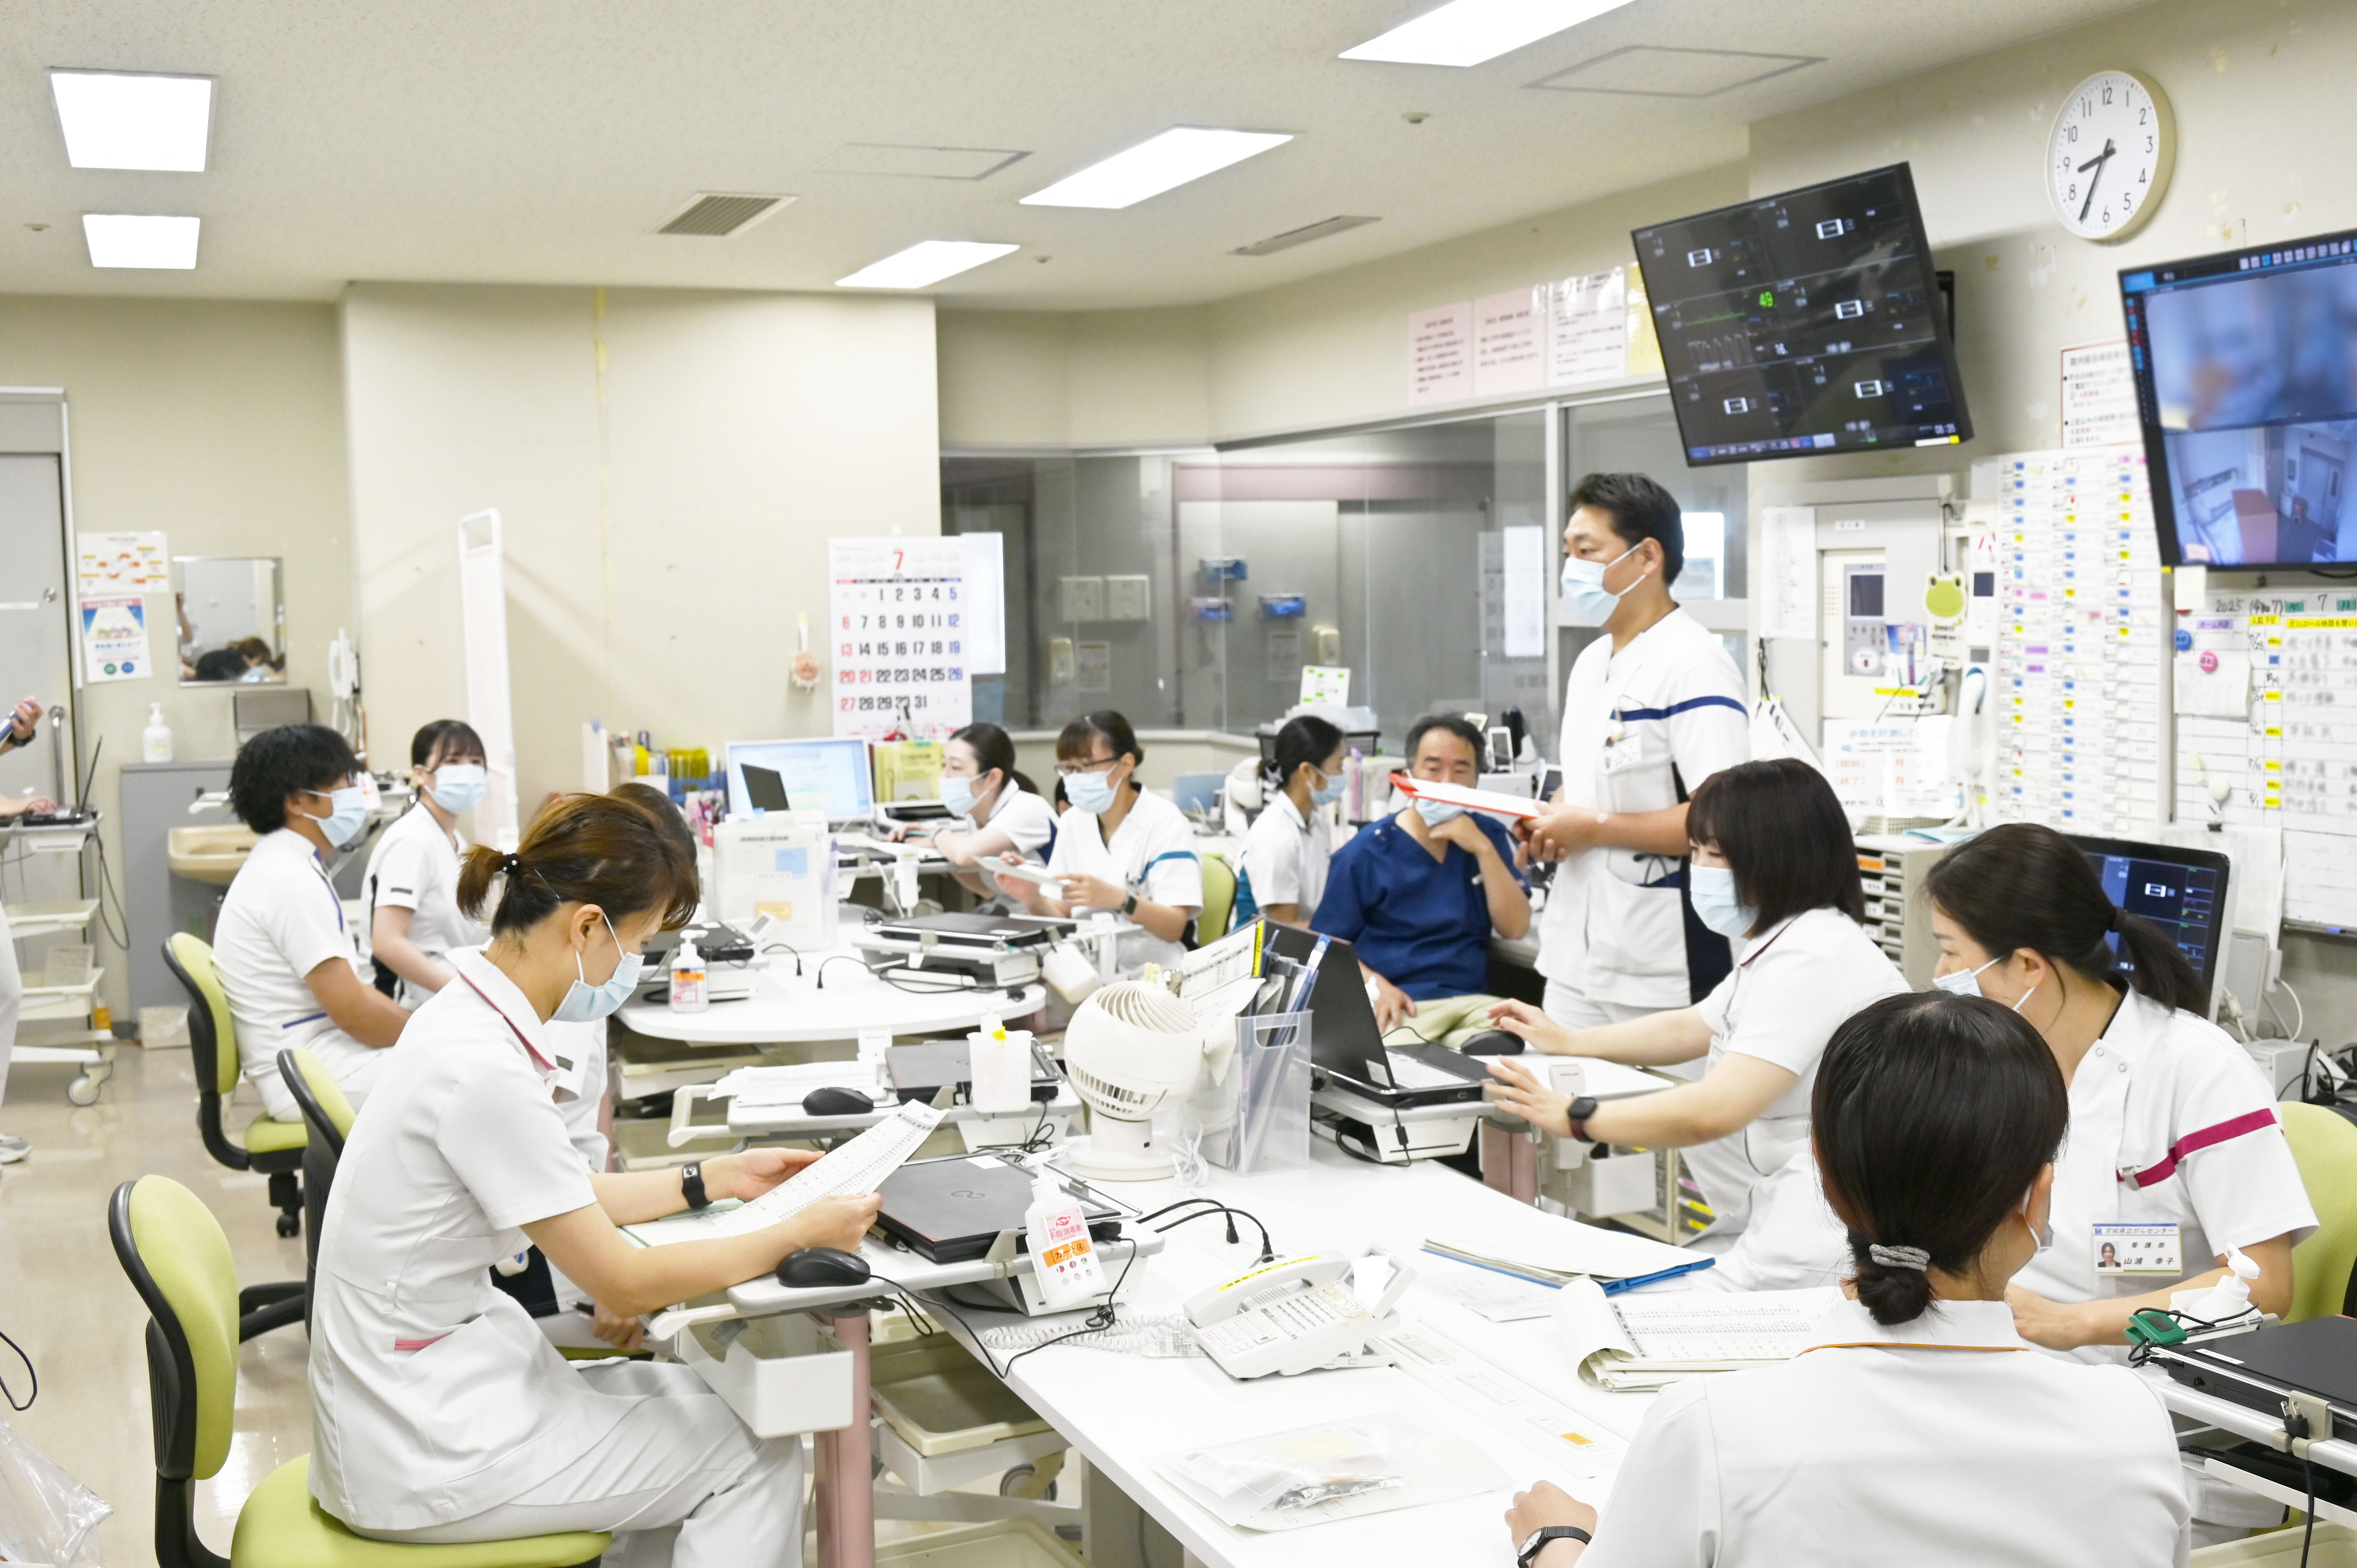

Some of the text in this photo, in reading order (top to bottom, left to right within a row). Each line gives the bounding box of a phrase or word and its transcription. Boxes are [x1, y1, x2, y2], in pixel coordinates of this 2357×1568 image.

[2103, 87, 2112, 105] 12
[2126, 90, 2129, 107] 1
[2083, 101, 2091, 118] 11
[2139, 108, 2146, 125] 2
[2068, 125, 2078, 143] 10
[2146, 136, 2153, 153] 3
[2063, 157, 2070, 173] 9
[2139, 168, 2146, 184] 4
[2069, 184, 2076, 200] 8
[2124, 193, 2131, 210] 5
[2103, 206, 2110, 222] 6
[1759, 291, 1774, 307] 49
[893, 551, 903, 570] 7
[879, 586, 957, 601] 1 2 3 4 5
[2215, 597, 2244, 613] 2025
[2318, 594, 2328, 611] 7
[842, 614, 959, 629] 6 7 8 9 10 11 12
[841, 641, 961, 656] 13 14 15 16 17 18 19
[840, 667, 962, 683] 20 21 22 23 24 25 26
[841, 697, 856, 711] 27
[859, 696, 874, 711] 28
[877, 696, 892, 710] 29
[914, 695, 927, 709] 31
